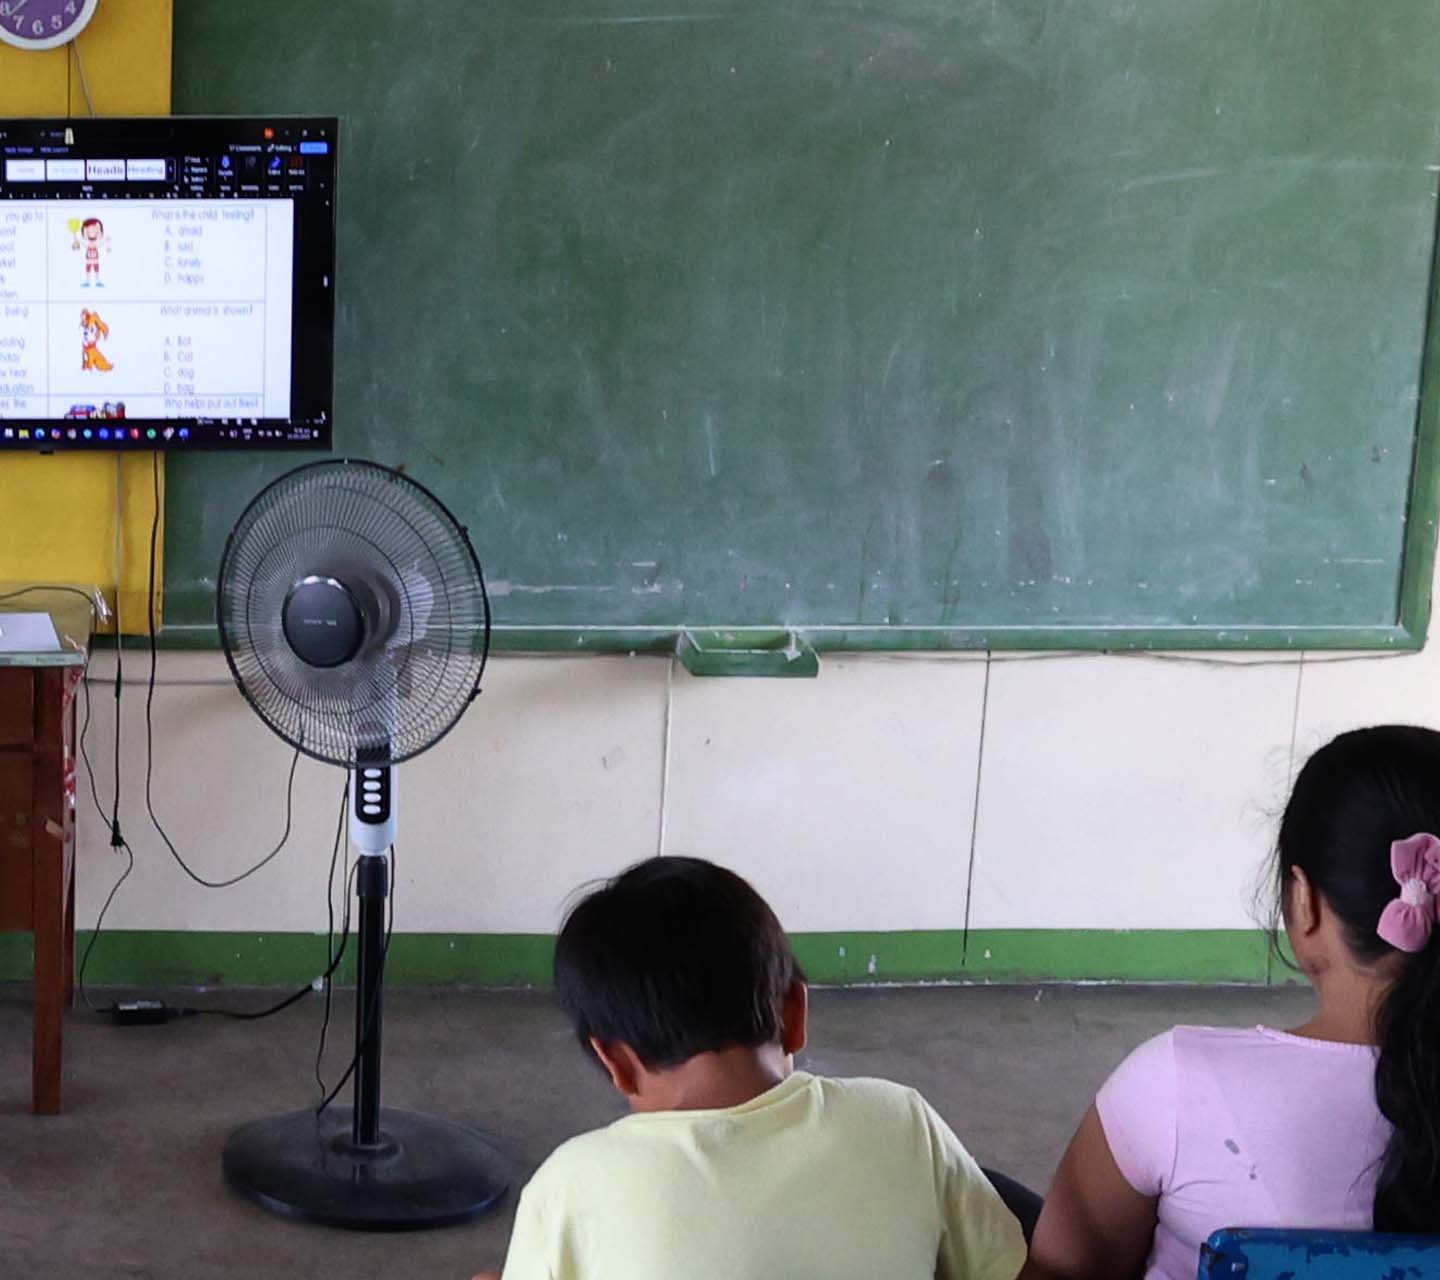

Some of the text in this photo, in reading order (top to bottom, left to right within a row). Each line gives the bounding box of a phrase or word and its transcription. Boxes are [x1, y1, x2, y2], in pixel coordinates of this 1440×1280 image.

[0, 1, 10, 16] 8
[65, 0, 76, 16] 4
[13, 15, 25, 30] 7
[32, 20, 44, 35] 6
[51, 15, 63, 30] 5
